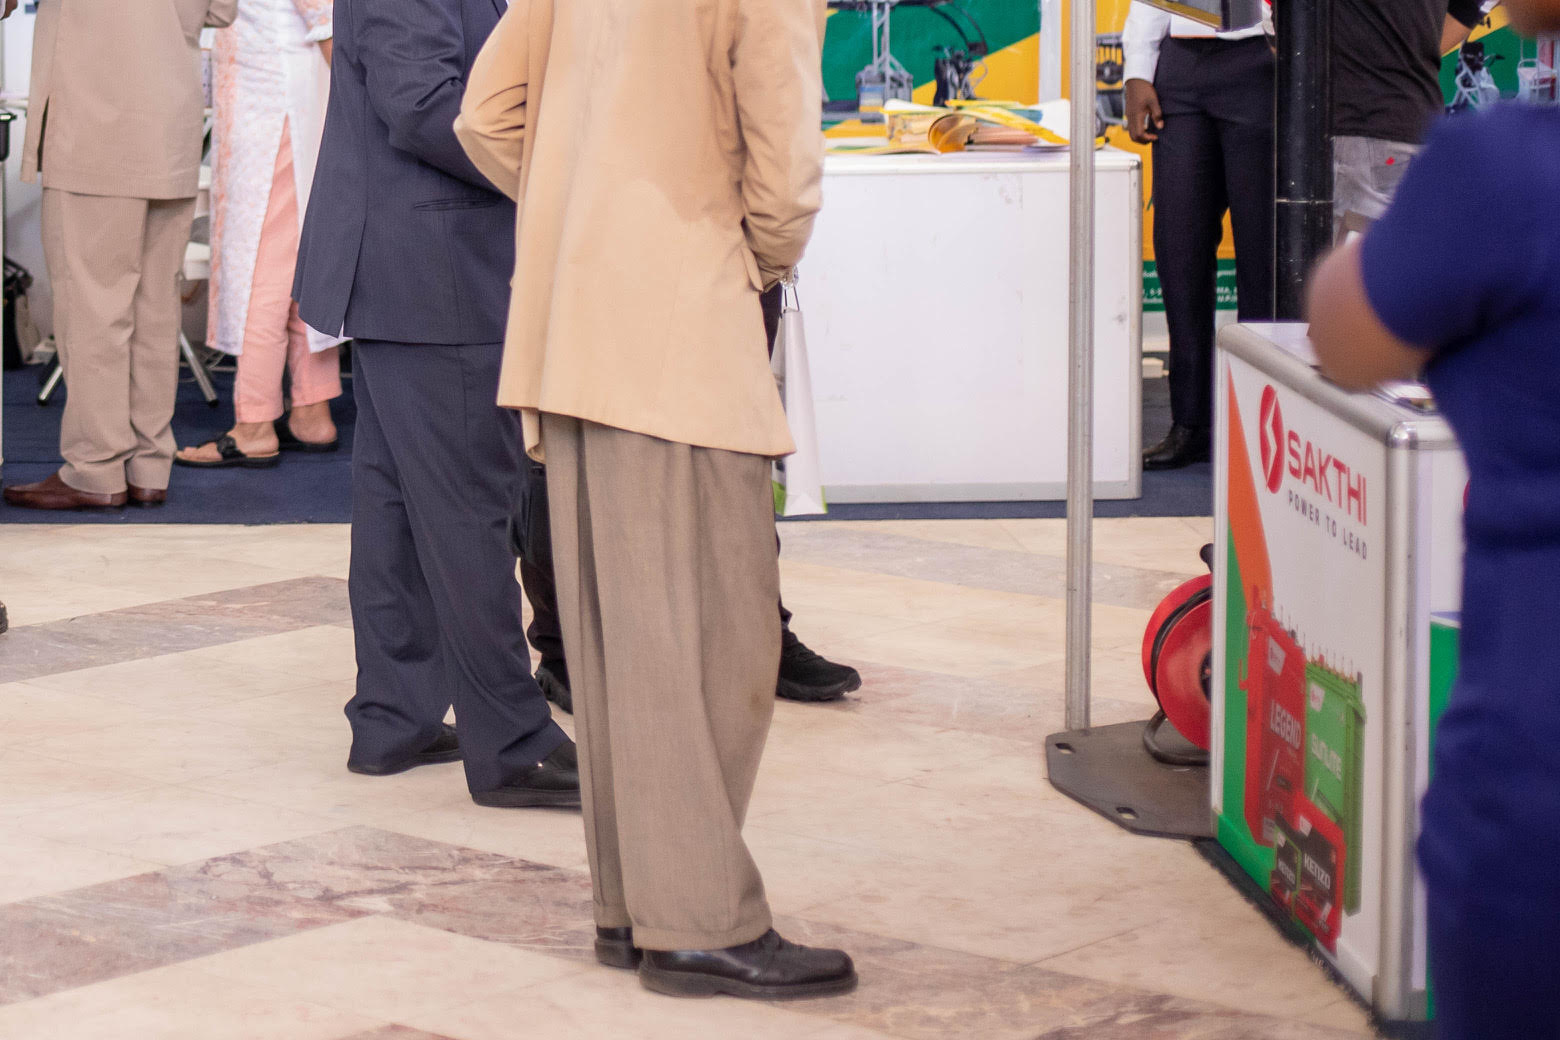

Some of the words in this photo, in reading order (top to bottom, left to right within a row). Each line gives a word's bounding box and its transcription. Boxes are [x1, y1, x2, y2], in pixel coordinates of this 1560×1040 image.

[1287, 429, 1368, 527] SAKTHI
[1288, 489, 1321, 528] POWER
[1325, 514, 1337, 538] TO
[1342, 527, 1368, 561] LEAD
[1270, 699, 1302, 750] LEGEND
